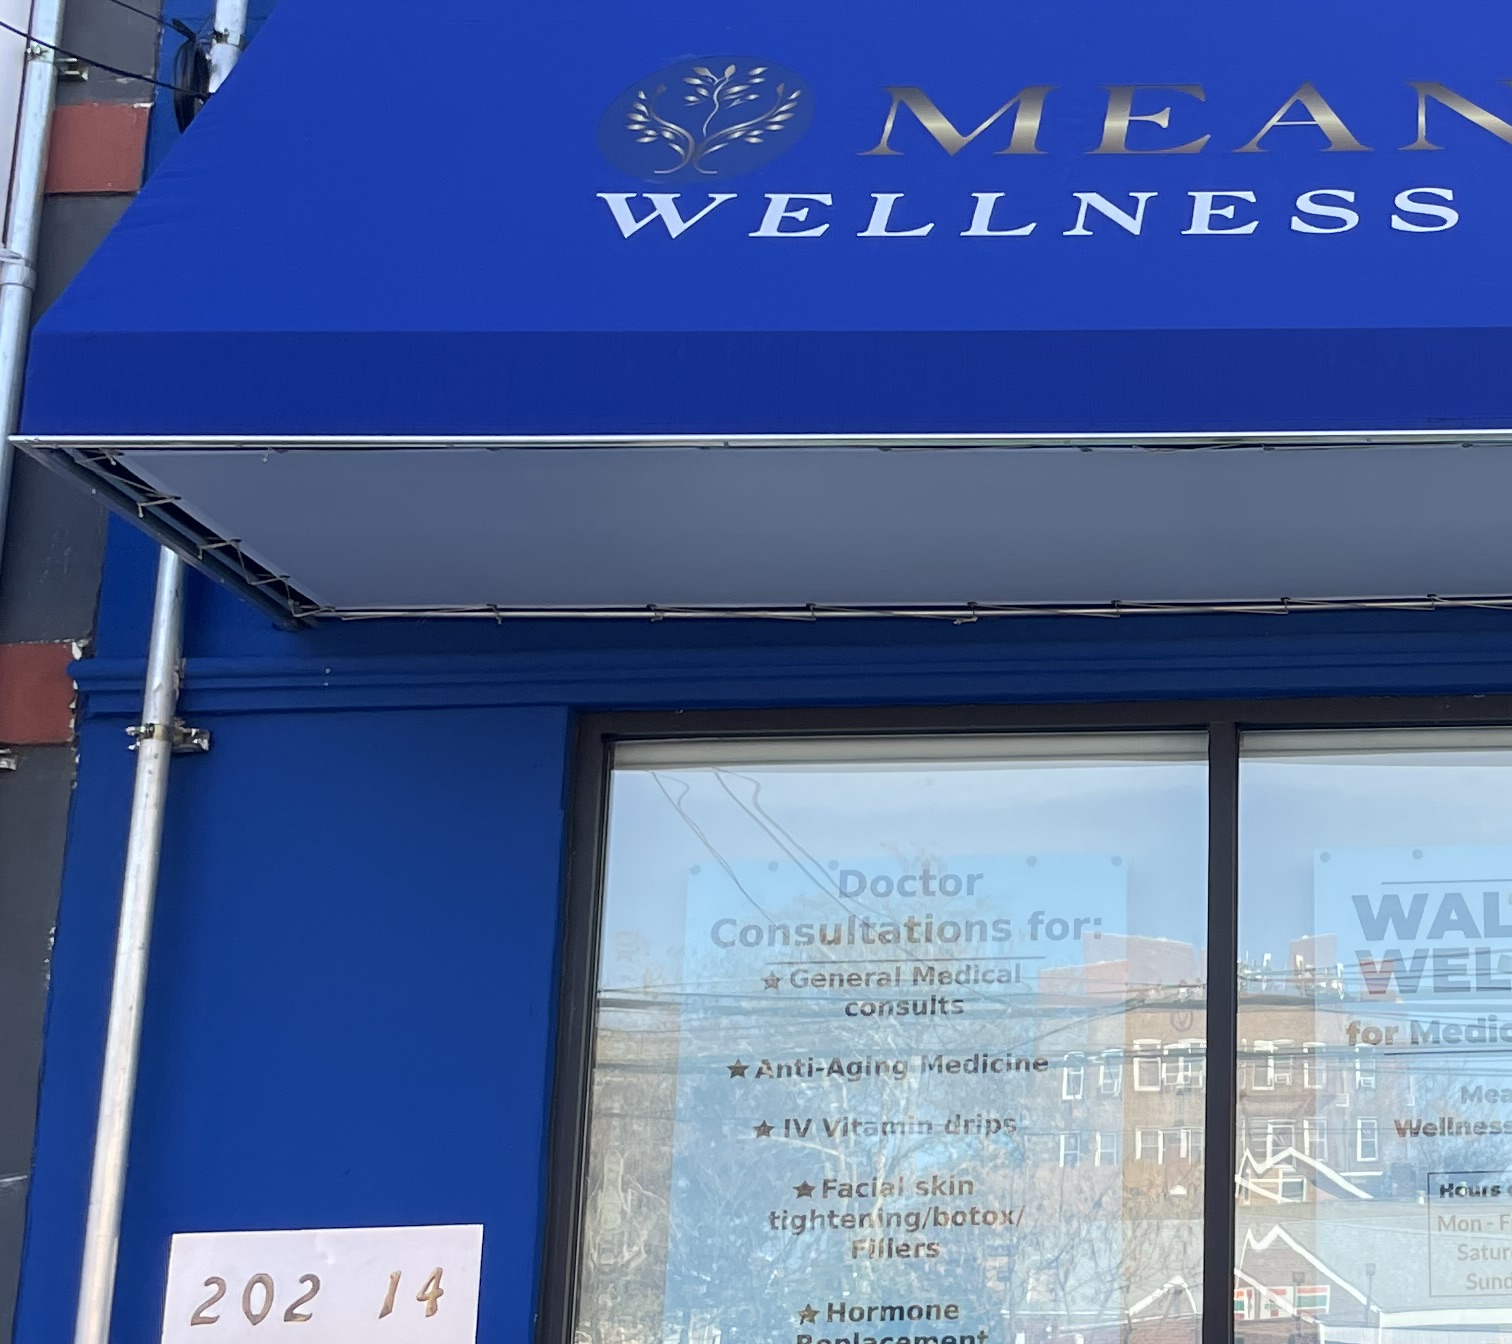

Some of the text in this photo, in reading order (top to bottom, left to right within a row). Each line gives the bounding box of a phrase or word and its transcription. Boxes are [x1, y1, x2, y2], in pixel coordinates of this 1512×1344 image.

[597, 184, 1461, 240] WELLNESS
[838, 868, 984, 899] Doctor
[710, 910, 1103, 950] Consultations for:
[789, 962, 1022, 990] General Medical
[844, 995, 965, 1018] consults
[1346, 1018, 1398, 1047] for
[755, 1053, 1050, 1083] Anti-Aging Medicine
[784, 1113, 1018, 1139] IV Vitamin drips
[821, 1174, 975, 1200] Facial skin
[1439, 1181, 1502, 1200] Hours
[768, 1204, 1027, 1236] tightening/botox/
[1437, 1213, 1482, 1233] Mon
[850, 1239, 942, 1260] Fillers
[190, 1266, 445, 1327] 202 14
[826, 1301, 961, 1323] Hormone
